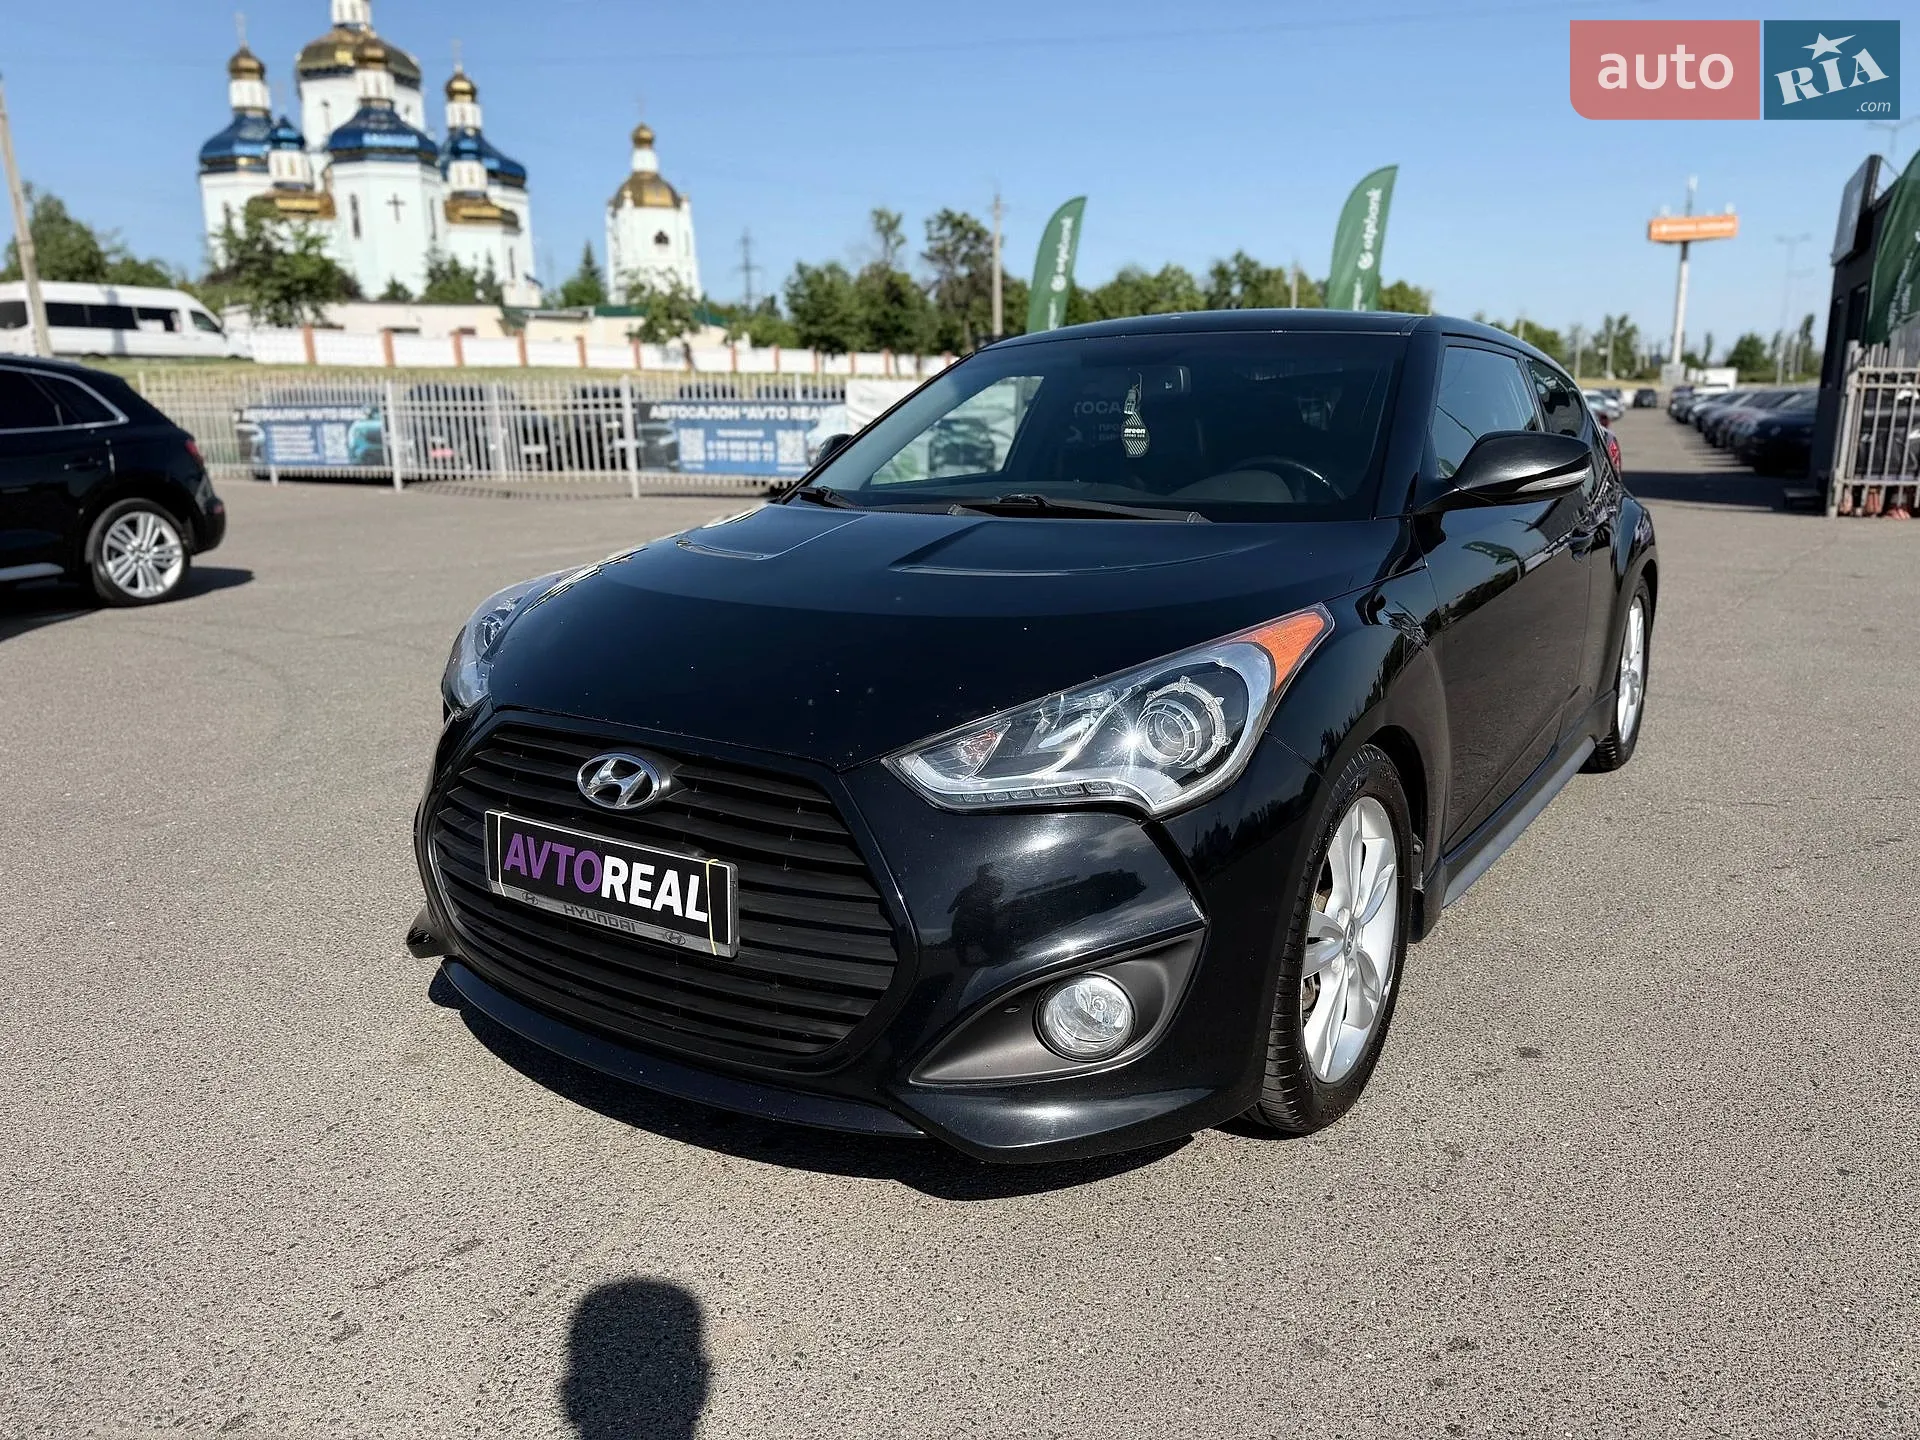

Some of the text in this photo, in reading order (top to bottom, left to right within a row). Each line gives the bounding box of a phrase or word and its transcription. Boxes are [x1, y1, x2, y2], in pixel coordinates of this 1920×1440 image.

[649, 405, 740, 420] АВТОСАЛОН
[503, 832, 709, 923] AVTOREAL
[562, 903, 638, 933] HYUNDAI
